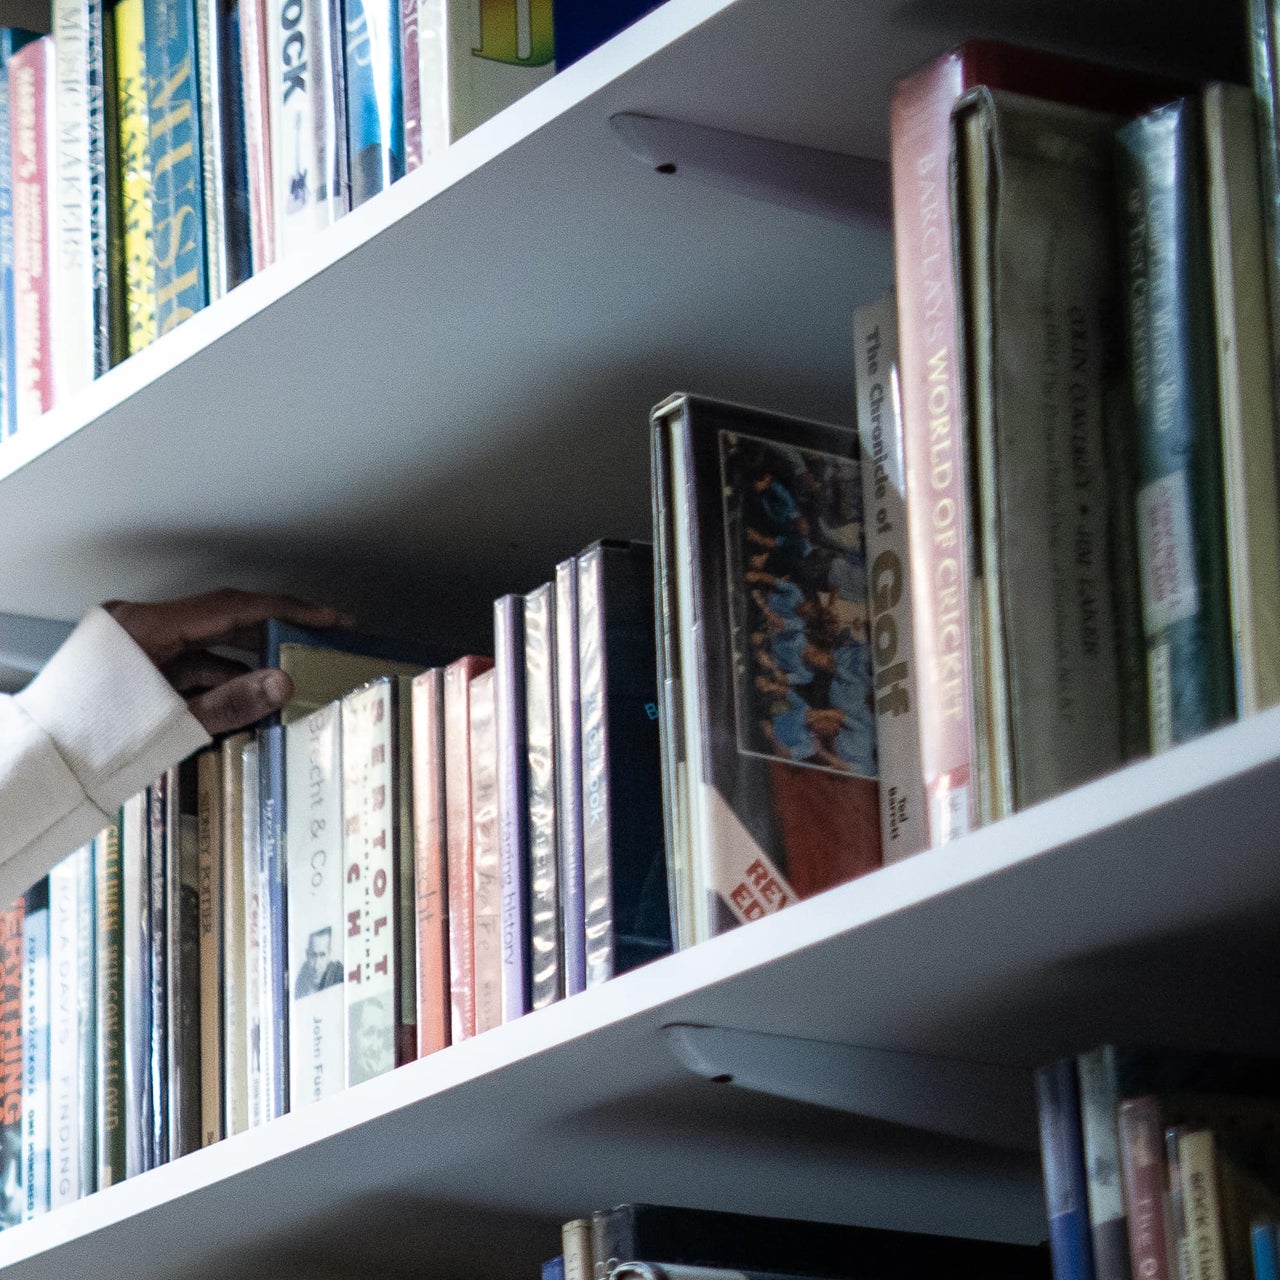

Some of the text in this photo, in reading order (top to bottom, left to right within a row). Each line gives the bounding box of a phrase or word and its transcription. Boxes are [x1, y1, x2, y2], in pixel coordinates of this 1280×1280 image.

[916, 151, 965, 723] BARCLAYS WORLD OF CRICKET
[1156, 376, 1179, 431] WHO
[865, 325, 911, 718] The Chronicle of Golf
[306, 712, 327, 897] Brecht & Co.
[370, 701, 389, 976] BERTOLT
[99, 824, 119, 932] SULLIVAN
[199, 791, 214, 936] SIDNEY POITIER
[503, 891, 518, 967] history
[100, 944, 119, 1035] WILSON
[311, 1015, 324, 1060] John
[27, 1108, 37, 1138] ONE
[57, 1074, 73, 1198] FINDING
[1137, 1197, 1154, 1247] The
[1191, 1171, 1211, 1227] ROCK
